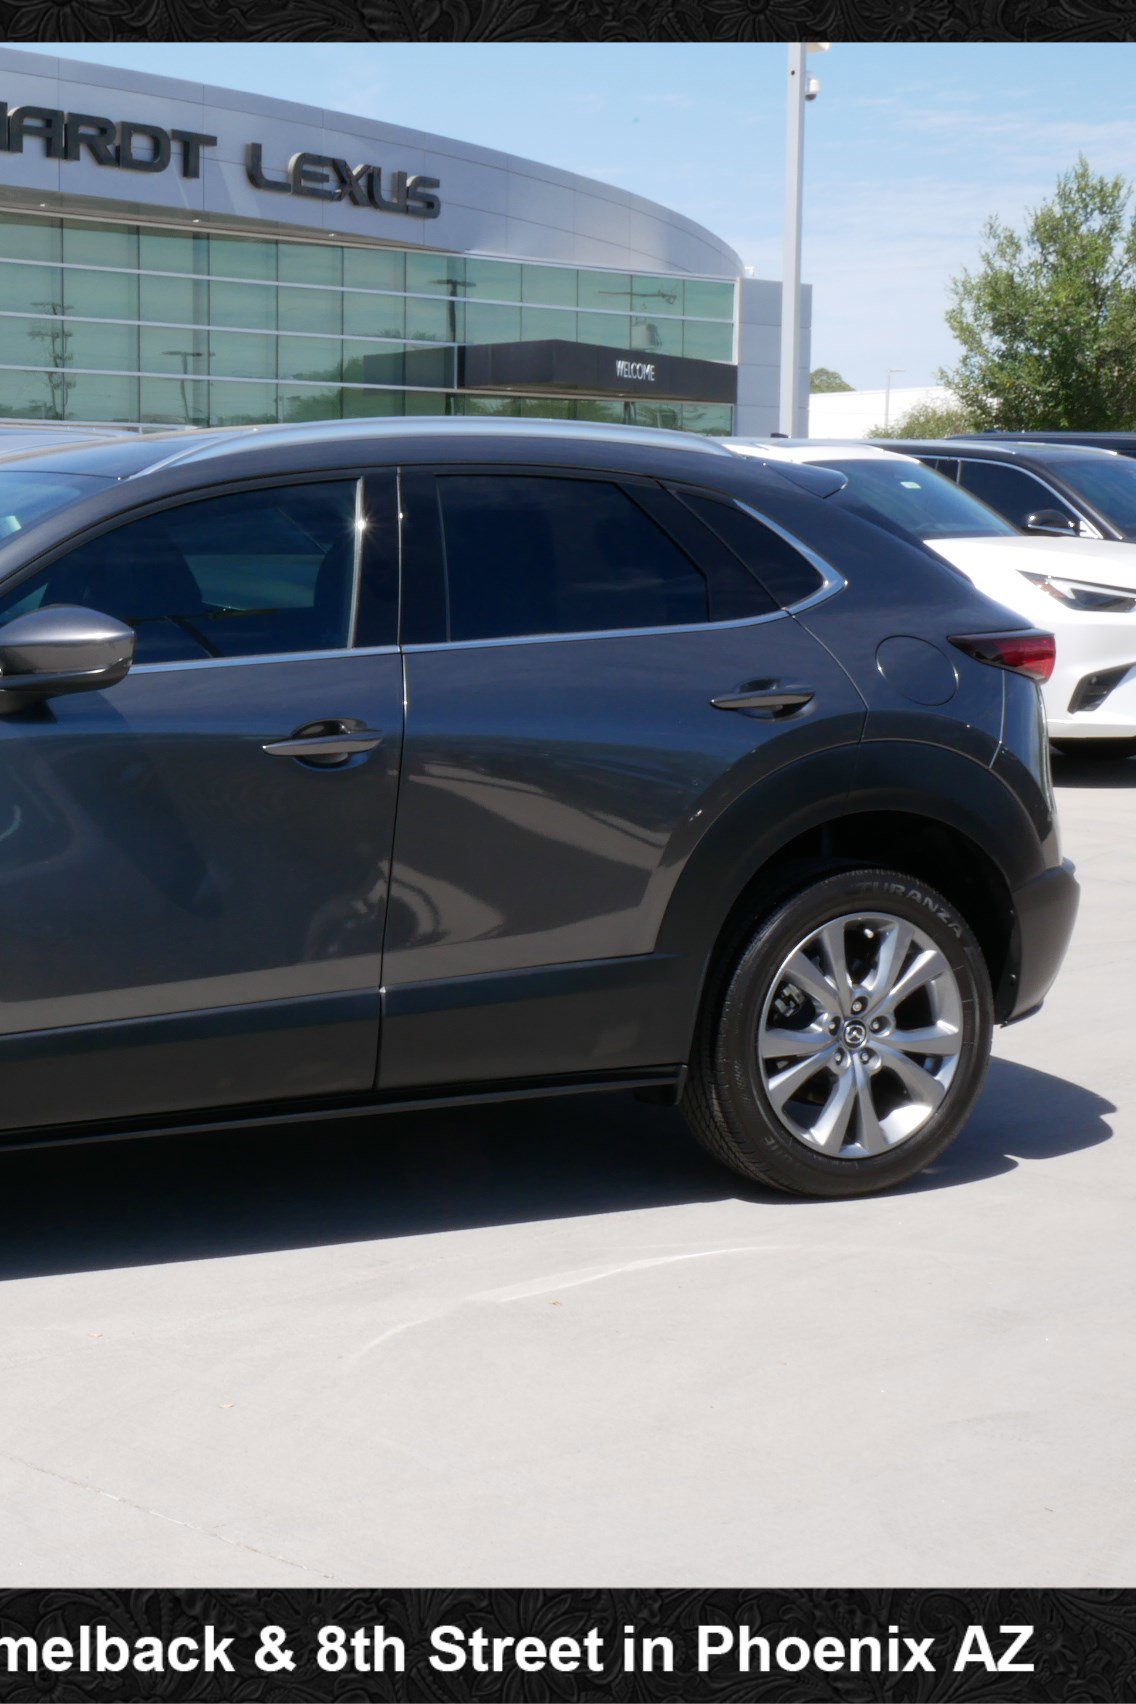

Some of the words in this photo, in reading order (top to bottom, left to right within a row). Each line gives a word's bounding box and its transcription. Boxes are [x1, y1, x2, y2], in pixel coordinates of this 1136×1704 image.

[246, 142, 442, 219] LEXUS
[615, 359, 656, 382] WELCOME
[854, 881, 963, 939] TURANZA
